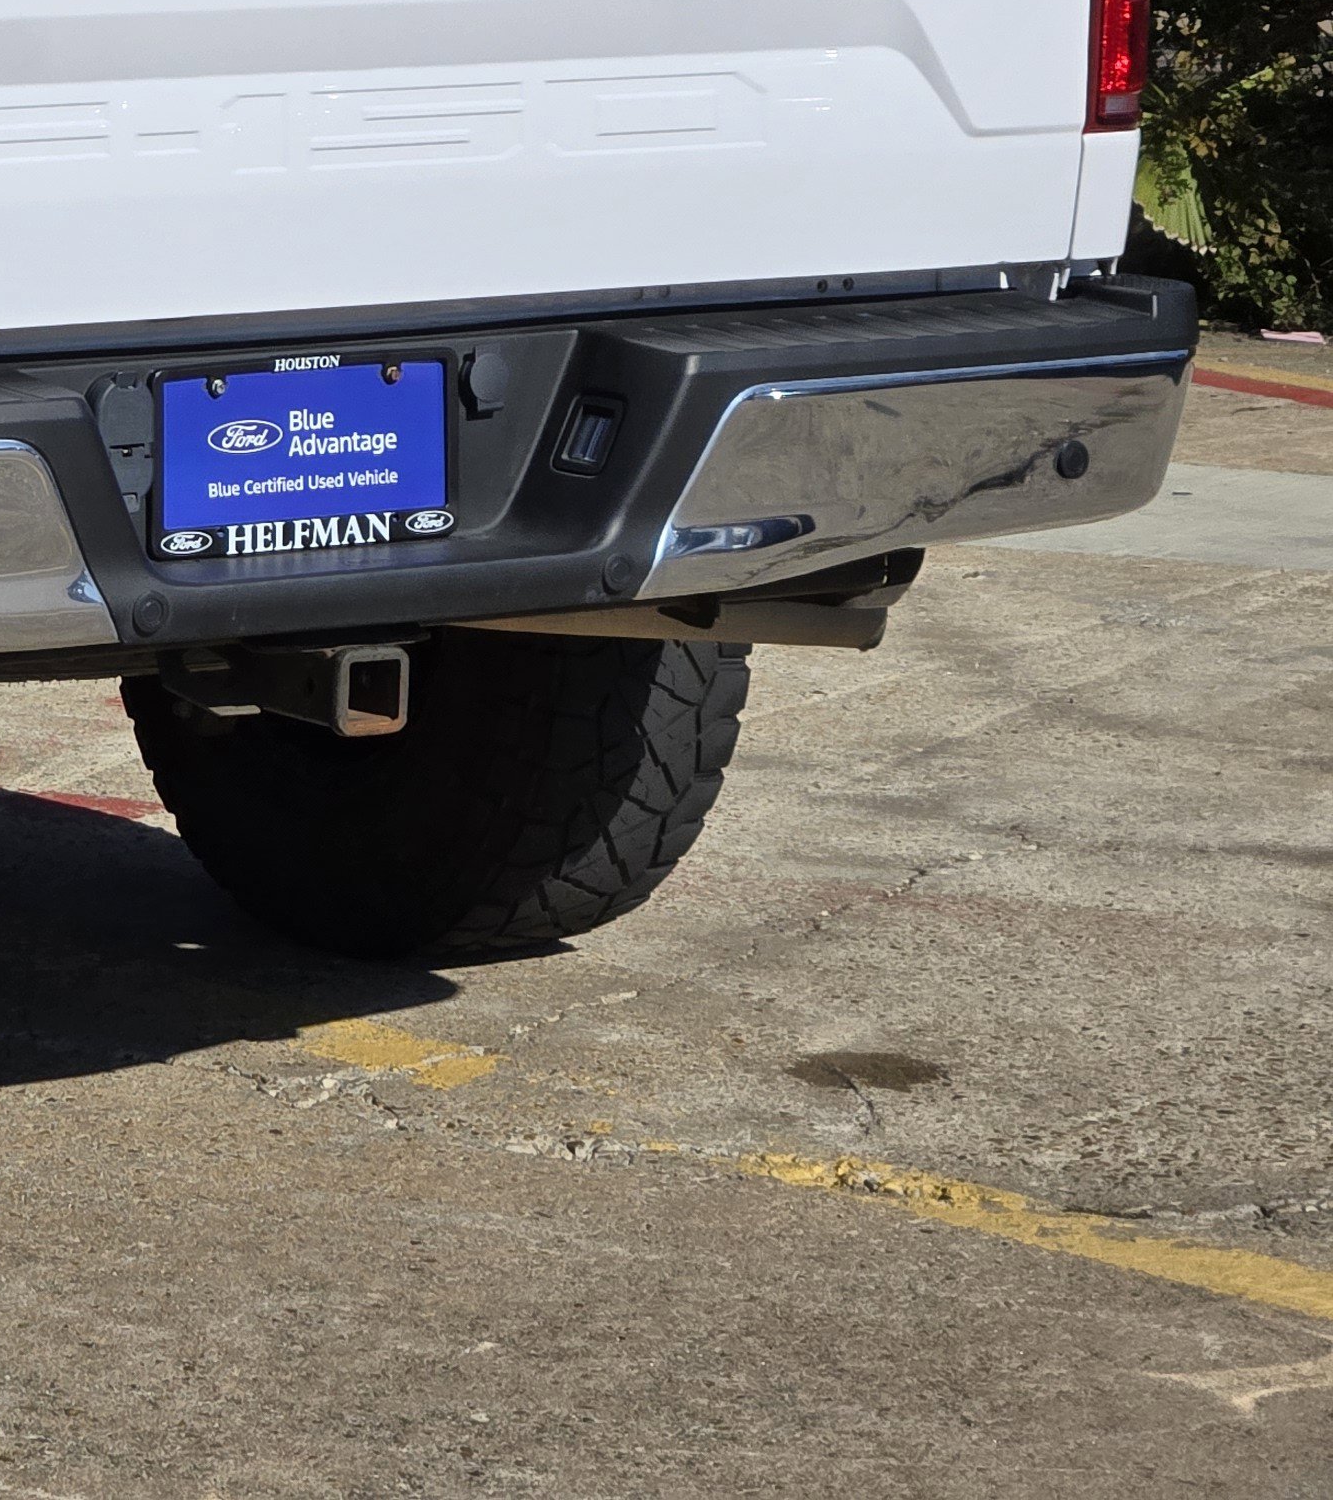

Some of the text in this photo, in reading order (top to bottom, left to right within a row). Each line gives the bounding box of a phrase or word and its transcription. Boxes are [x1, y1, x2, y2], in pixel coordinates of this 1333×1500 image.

[274, 354, 341, 372] HOUSTON
[289, 408, 335, 432] Blue
[221, 424, 269, 450] Ford
[288, 431, 398, 457] Advantage
[208, 468, 399, 499] Blue Certified Used Vehicle
[226, 511, 393, 556] HELFMAN
